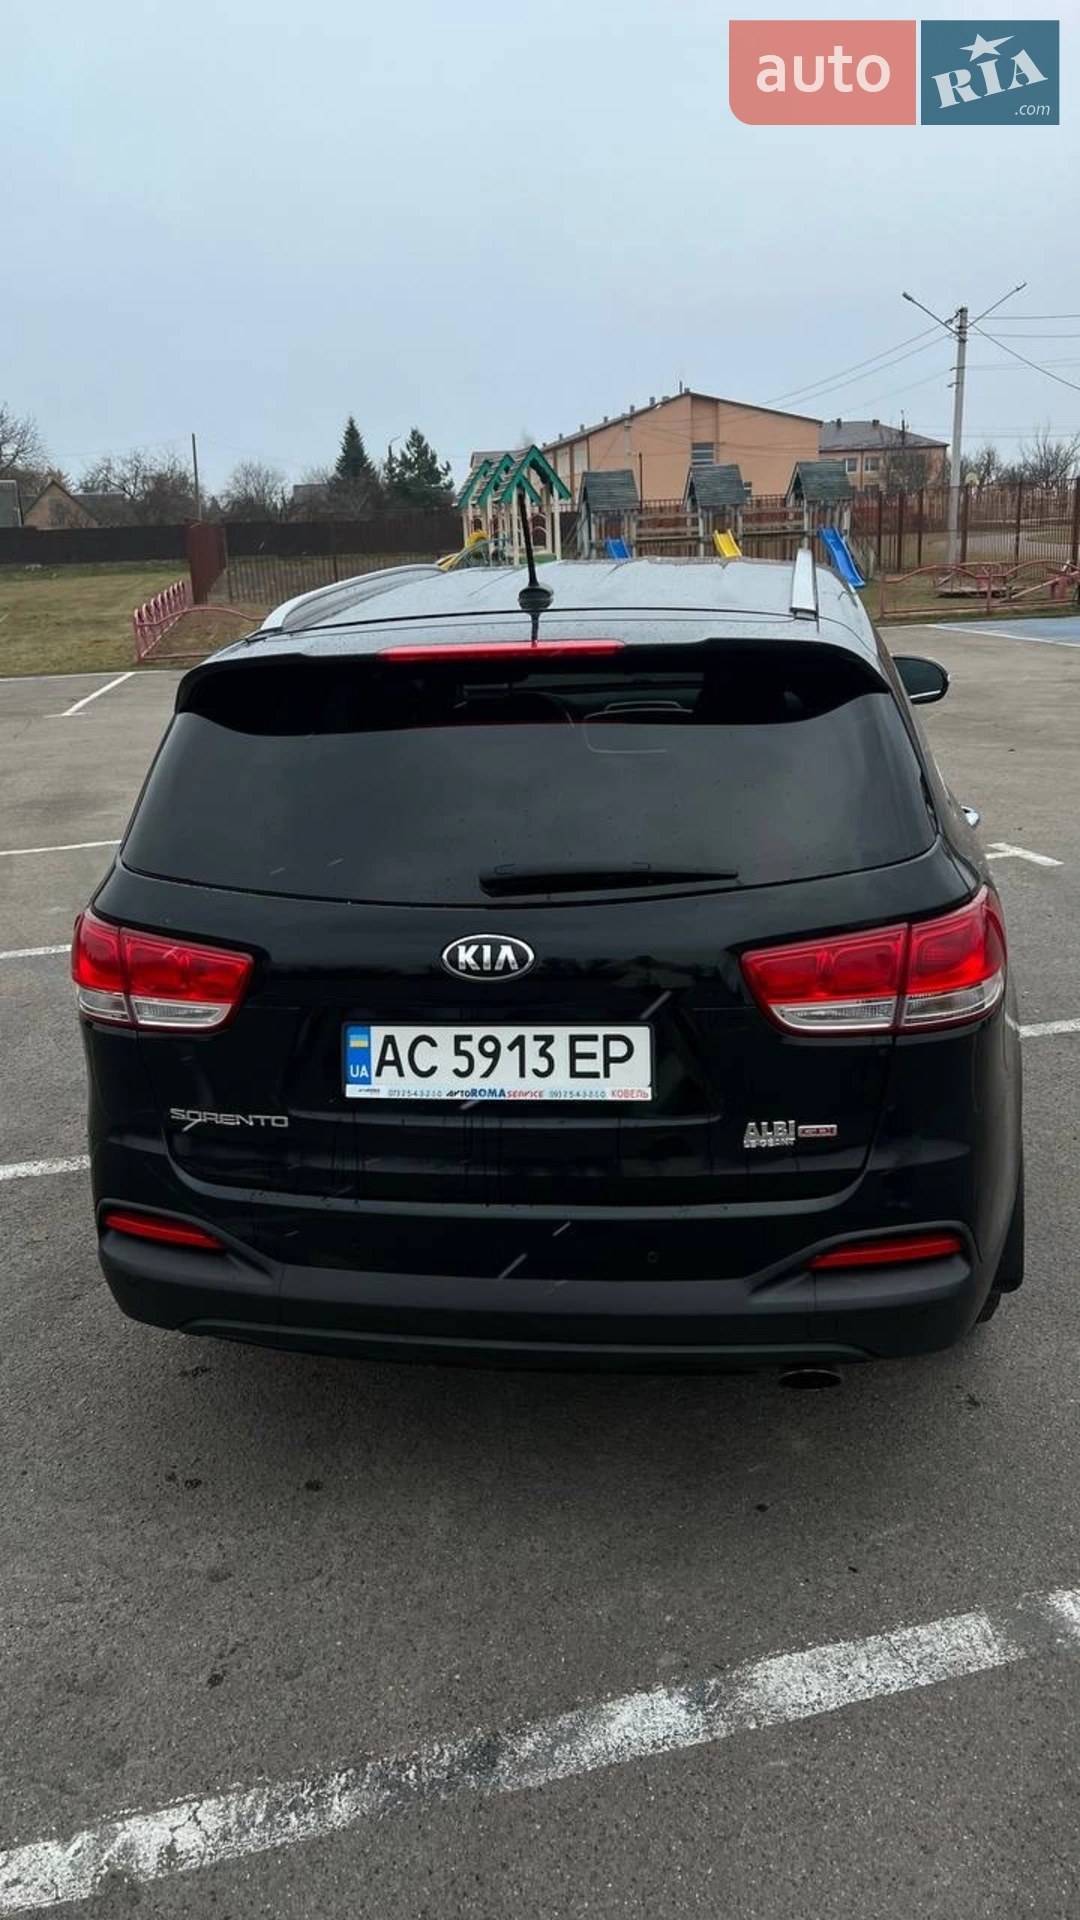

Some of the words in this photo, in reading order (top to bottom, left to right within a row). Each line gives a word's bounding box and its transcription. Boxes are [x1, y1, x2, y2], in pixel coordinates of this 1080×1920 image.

[457, 944, 519, 971] KIA
[375, 1034, 438, 1078] AC
[452, 1034, 555, 1079] 5913
[568, 1034, 634, 1079] EP
[349, 1065, 370, 1079] UA
[170, 1108, 289, 1132] SORENTO
